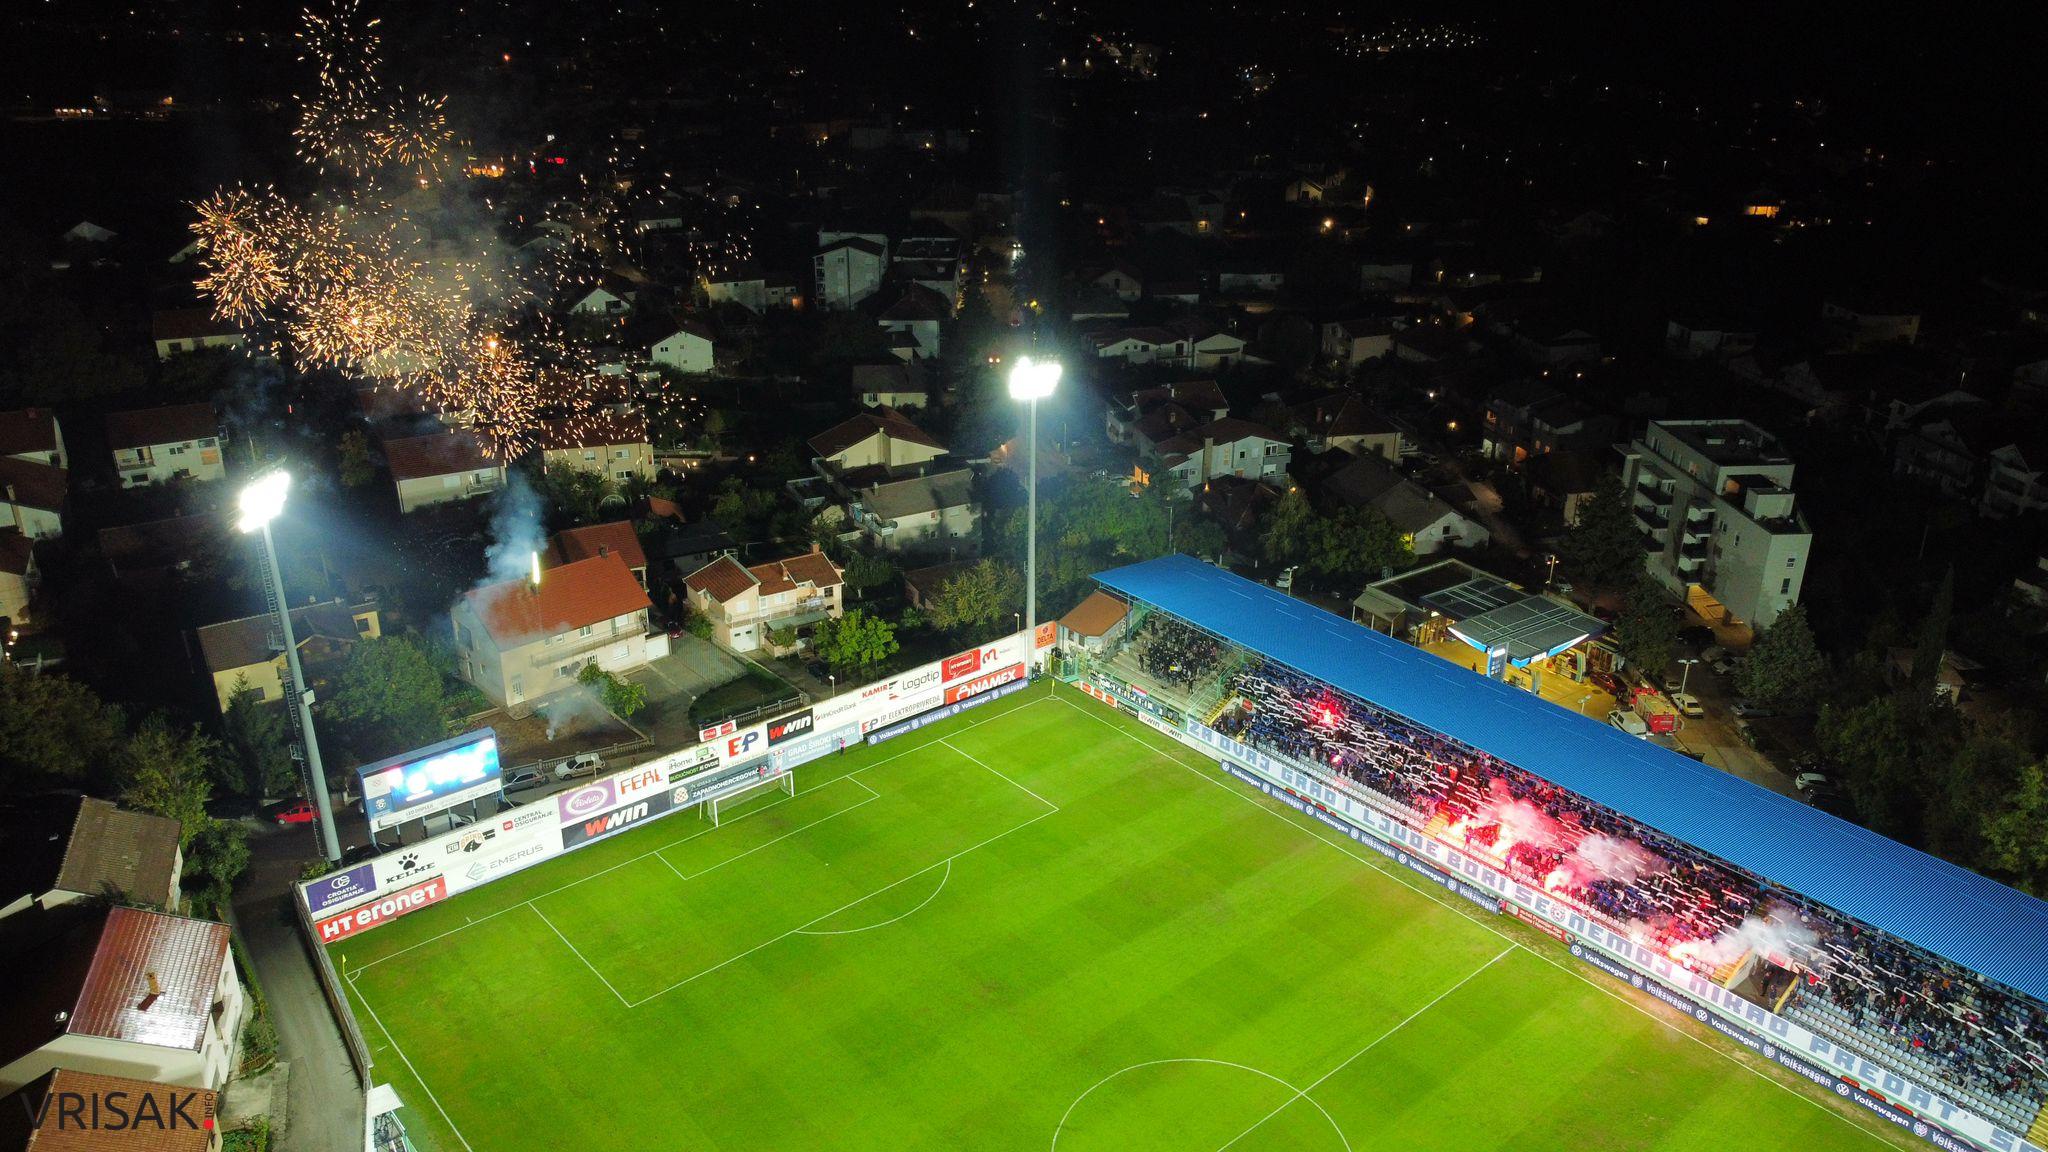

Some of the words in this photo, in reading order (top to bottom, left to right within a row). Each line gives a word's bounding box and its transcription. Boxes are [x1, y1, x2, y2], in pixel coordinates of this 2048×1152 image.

[902, 671, 939, 690] Logotip
[962, 695, 991, 710] Volkswagen
[879, 724, 910, 740] Volkswagen
[727, 731, 759, 758] EP
[620, 768, 663, 795] FEAL
[1231, 767, 1261, 788] Volkswagen
[513, 810, 542, 822] CENTRAL
[515, 811, 553, 828] OSIGURANJE
[1315, 811, 1349, 833] Volkswagen
[489, 844, 543, 869] EMERUS
[1363, 808, 1439, 858] LJUDE
[1446, 850, 1507, 892] BORI
[1514, 884, 1551, 914] SE
[386, 862, 436, 884] KELME
[1408, 860, 1445, 884] Volkswagen
[322, 888, 365, 906] OSIGURANJE
[327, 885, 358, 899] CROATIA
[1459, 886, 1498, 913] Volkswagen
[323, 915, 353, 938] HT
[1584, 952, 1629, 980] Volkswagen
[1646, 982, 1693, 1014] Volkswagen
[1711, 1018, 1760, 1050] Volkswagen
[1779, 1052, 1832, 1088] Volkswagen
[1854, 1092, 1910, 1127] Volkswagen
